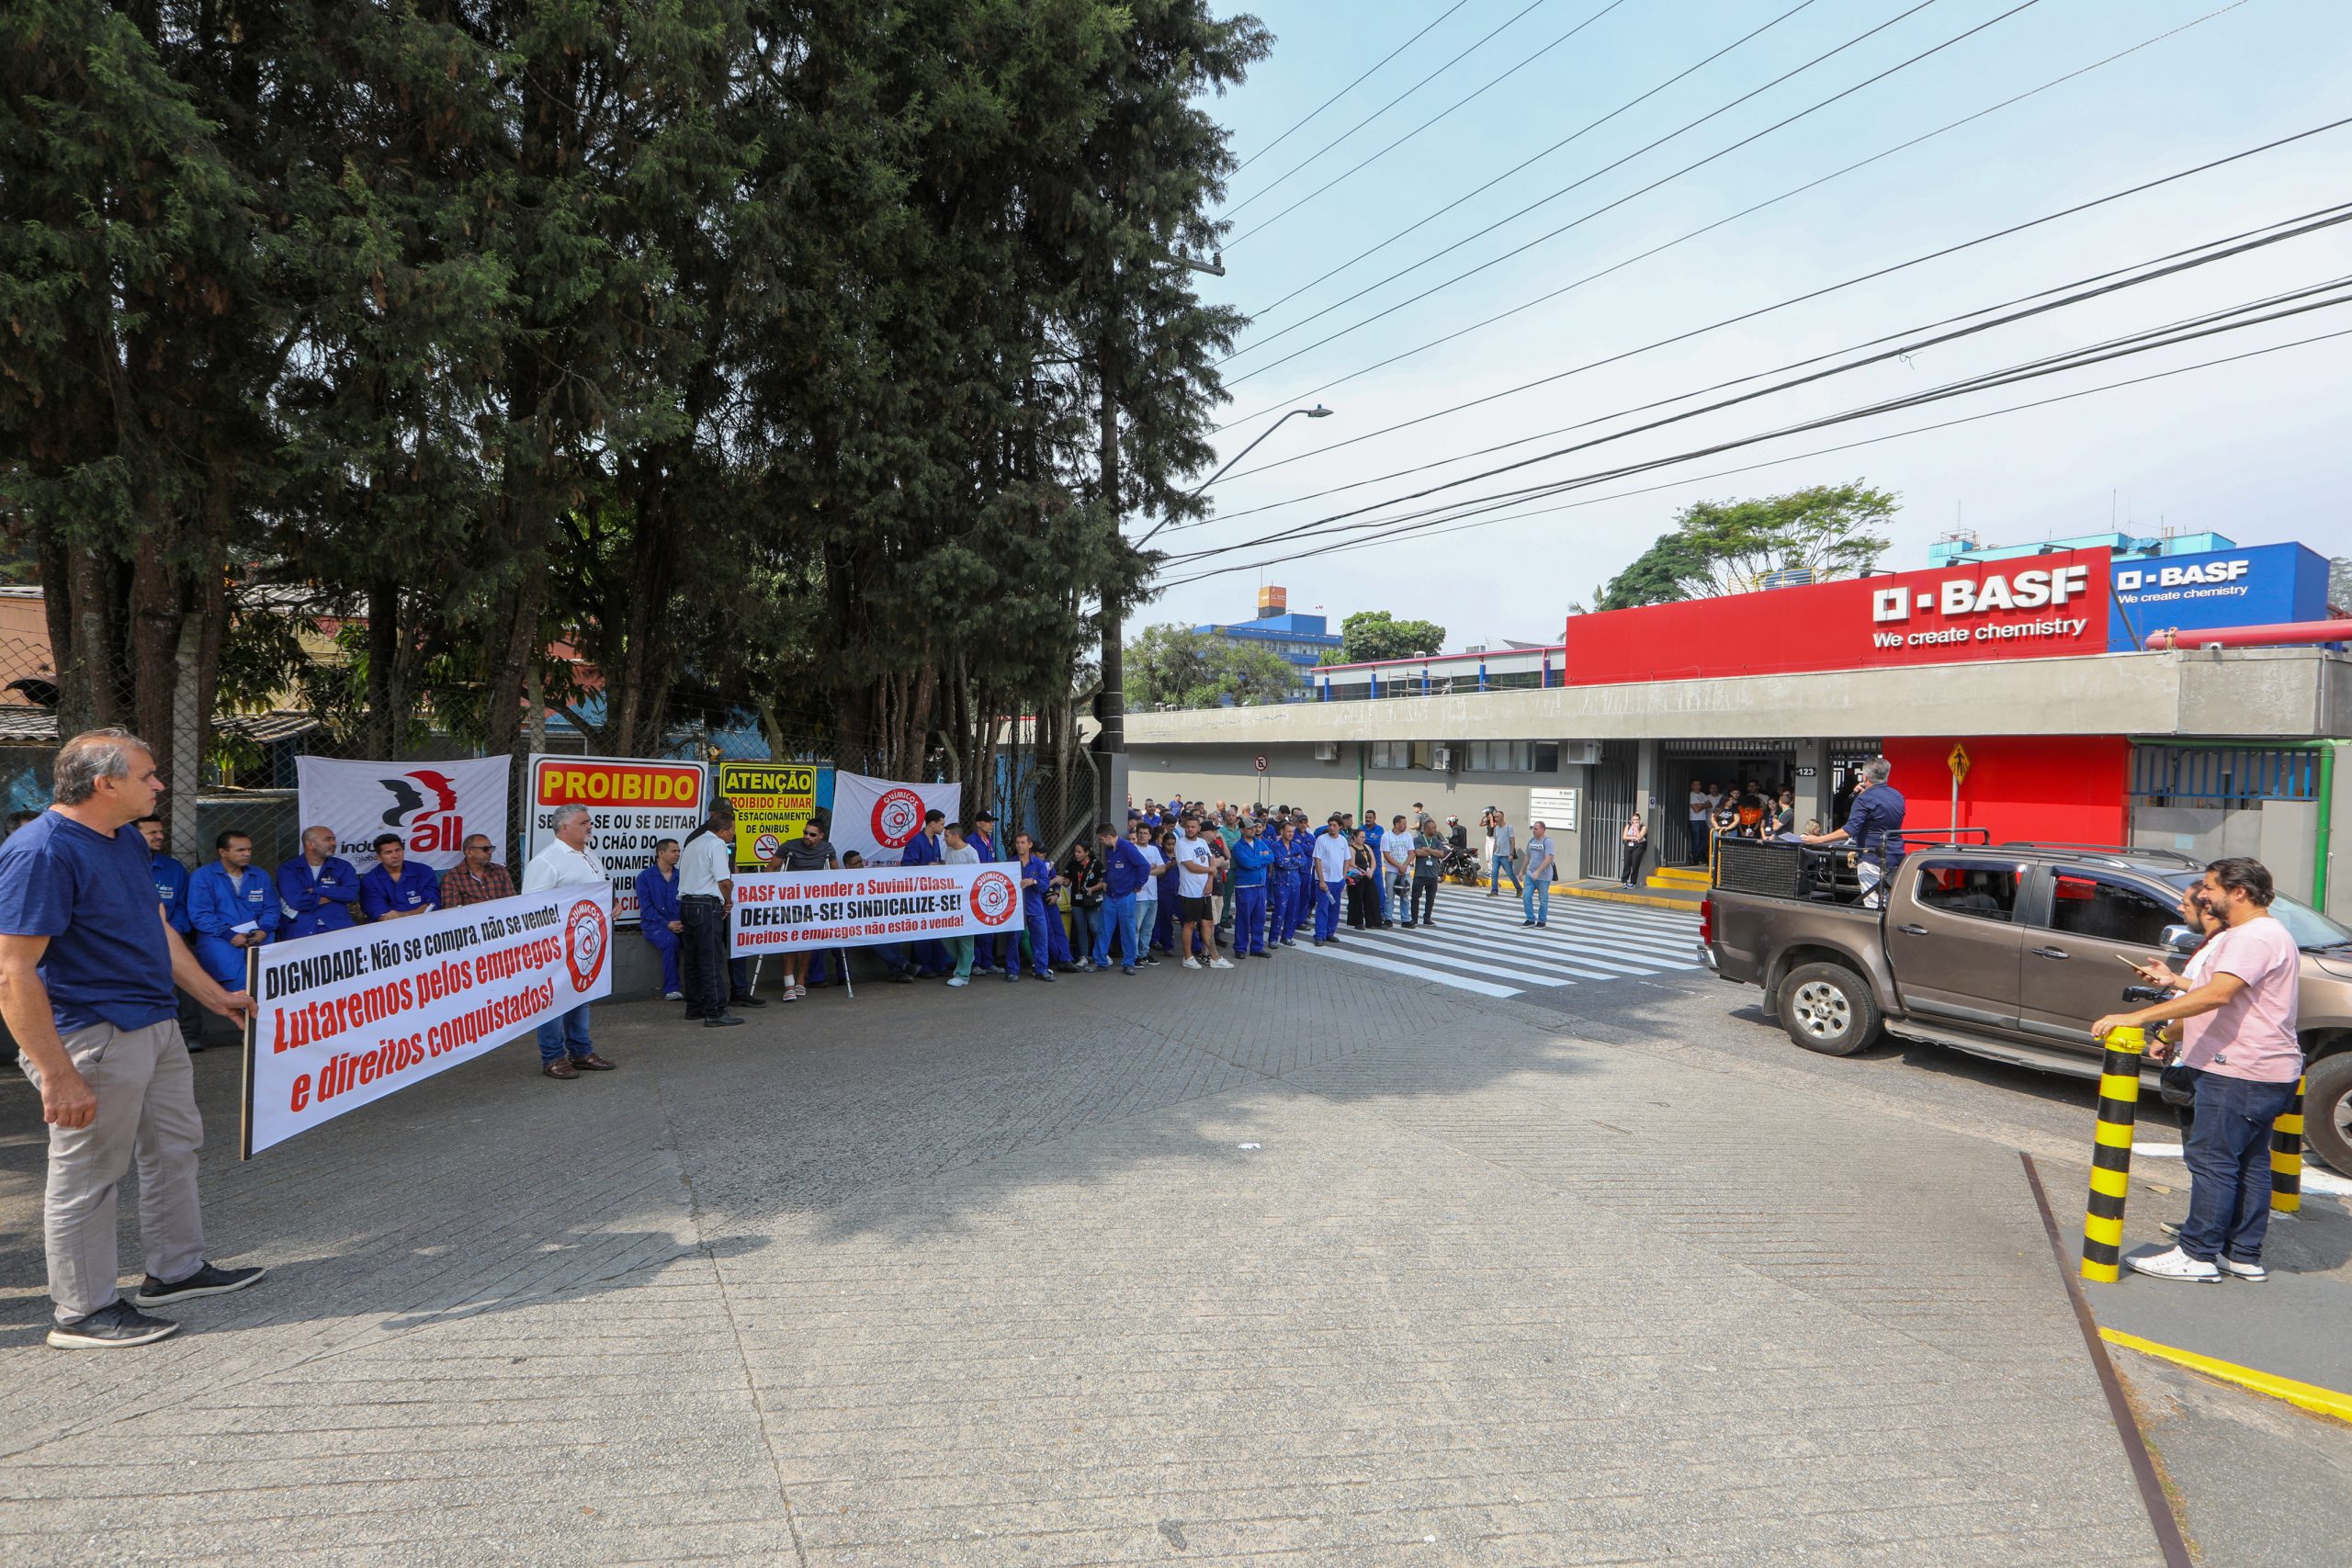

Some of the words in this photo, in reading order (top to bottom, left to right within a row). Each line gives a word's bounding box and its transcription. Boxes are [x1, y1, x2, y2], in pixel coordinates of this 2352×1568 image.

[2161, 559, 2249, 587] BASF
[1941, 565, 2088, 615] BASF
[2118, 594, 2138, 604] We
[2141, 591, 2180, 602] create
[2184, 586, 2248, 599] chemistry
[1873, 632, 1903, 648] We
[1907, 626, 1970, 646] create
[1975, 618, 2087, 640] chemistry
[543, 771, 695, 801] PROIBIDO
[726, 770, 811, 794] ATENÇÃO
[730, 796, 774, 808] ROIBIDO
[777, 796, 811, 808] FUMAR
[884, 790, 919, 807] QUÍMICOS
[614, 815, 632, 829] OU
[636, 815, 651, 829] SE
[654, 815, 696, 829] DEITAR
[739, 811, 811, 821] ESTACIONAMENTO
[746, 825, 756, 833] DE
[759, 823, 789, 833] ÔNIBUS
[603, 832, 637, 850] CHÃO
[641, 835, 658, 850] DO
[977, 872, 1008, 886] QUÍMICOS
[738, 885, 775, 903] BASF
[778, 884, 800, 900] vai
[804, 882, 854, 899] vender
[856, 882, 865, 896] a
[570, 903, 601, 928] QUÍMICOS
[741, 902, 843, 927] DEFENDA-SE!
[847, 894, 961, 919] SINDICALIZE-SE!
[737, 931, 788, 947] Direitos
[790, 930, 798, 942] e
[801, 924, 863, 941] empregos
[865, 921, 888, 935] não
[888, 919, 918, 933] estão
[921, 918, 927, 931] à
[930, 915, 964, 929] venda!
[266, 946, 368, 1000] DIGNIDADE:
[370, 939, 401, 972] Não
[403, 940, 422, 963] se
[424, 924, 481, 956] compra,
[481, 916, 504, 942] não
[506, 916, 522, 935] se
[523, 903, 561, 931] vende!
[274, 978, 413, 1055] Lutaremos
[416, 960, 472, 1010] pelos
[476, 935, 562, 985] empregos
[290, 1073, 311, 1112] e
[317, 1032, 425, 1103] direitos
[427, 976, 554, 1058] conquistados!
